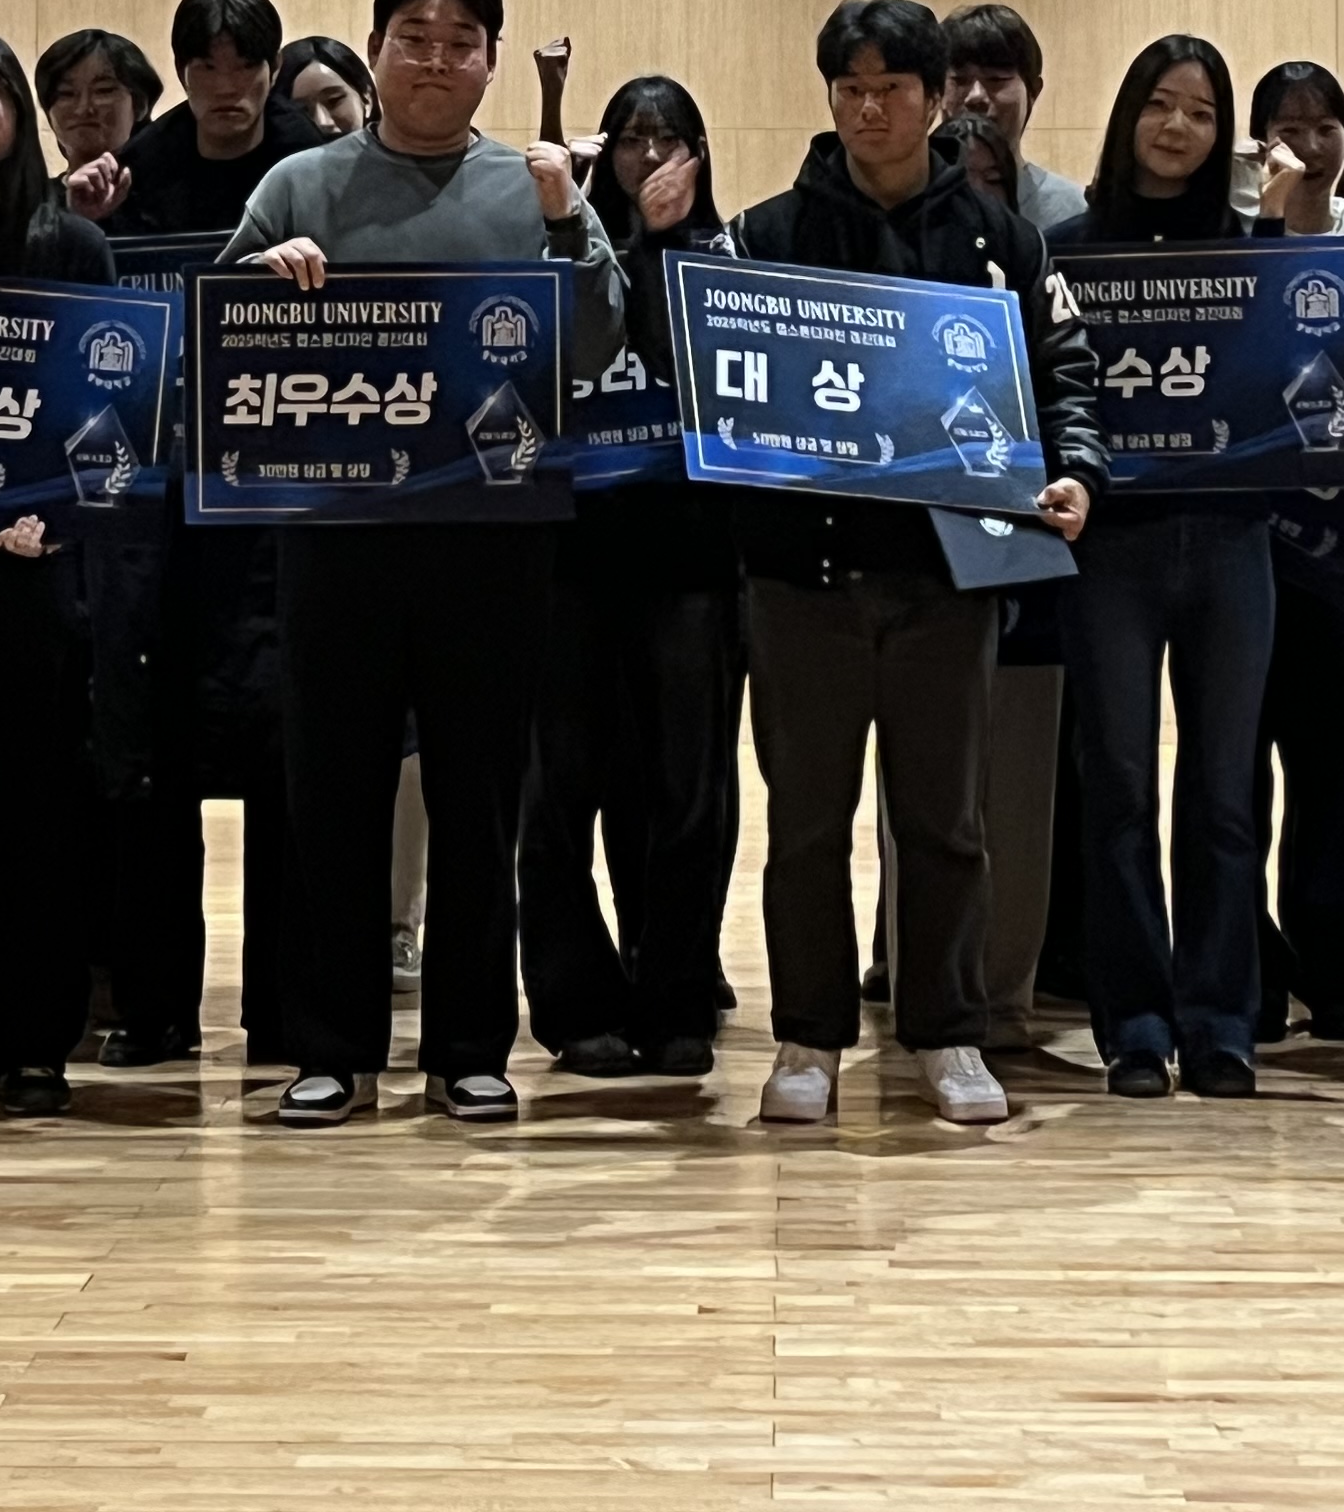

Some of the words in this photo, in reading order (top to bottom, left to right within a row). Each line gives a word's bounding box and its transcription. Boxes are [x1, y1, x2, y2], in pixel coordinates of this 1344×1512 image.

[220, 302, 316, 325] JOONGBU
[323, 301, 443, 324] UNIVERSITY
[704, 288, 792, 316] JOONGBU
[797, 299, 906, 330] UNIVERSITY
[1072, 280, 1136, 303] ONGBU
[1142, 276, 1258, 300] UNIVERSITY
[715, 348, 769, 404] 대
[811, 359, 865, 413] 상
[1104, 345, 1211, 399] 수상
[222, 371, 438, 427] 최우수상
